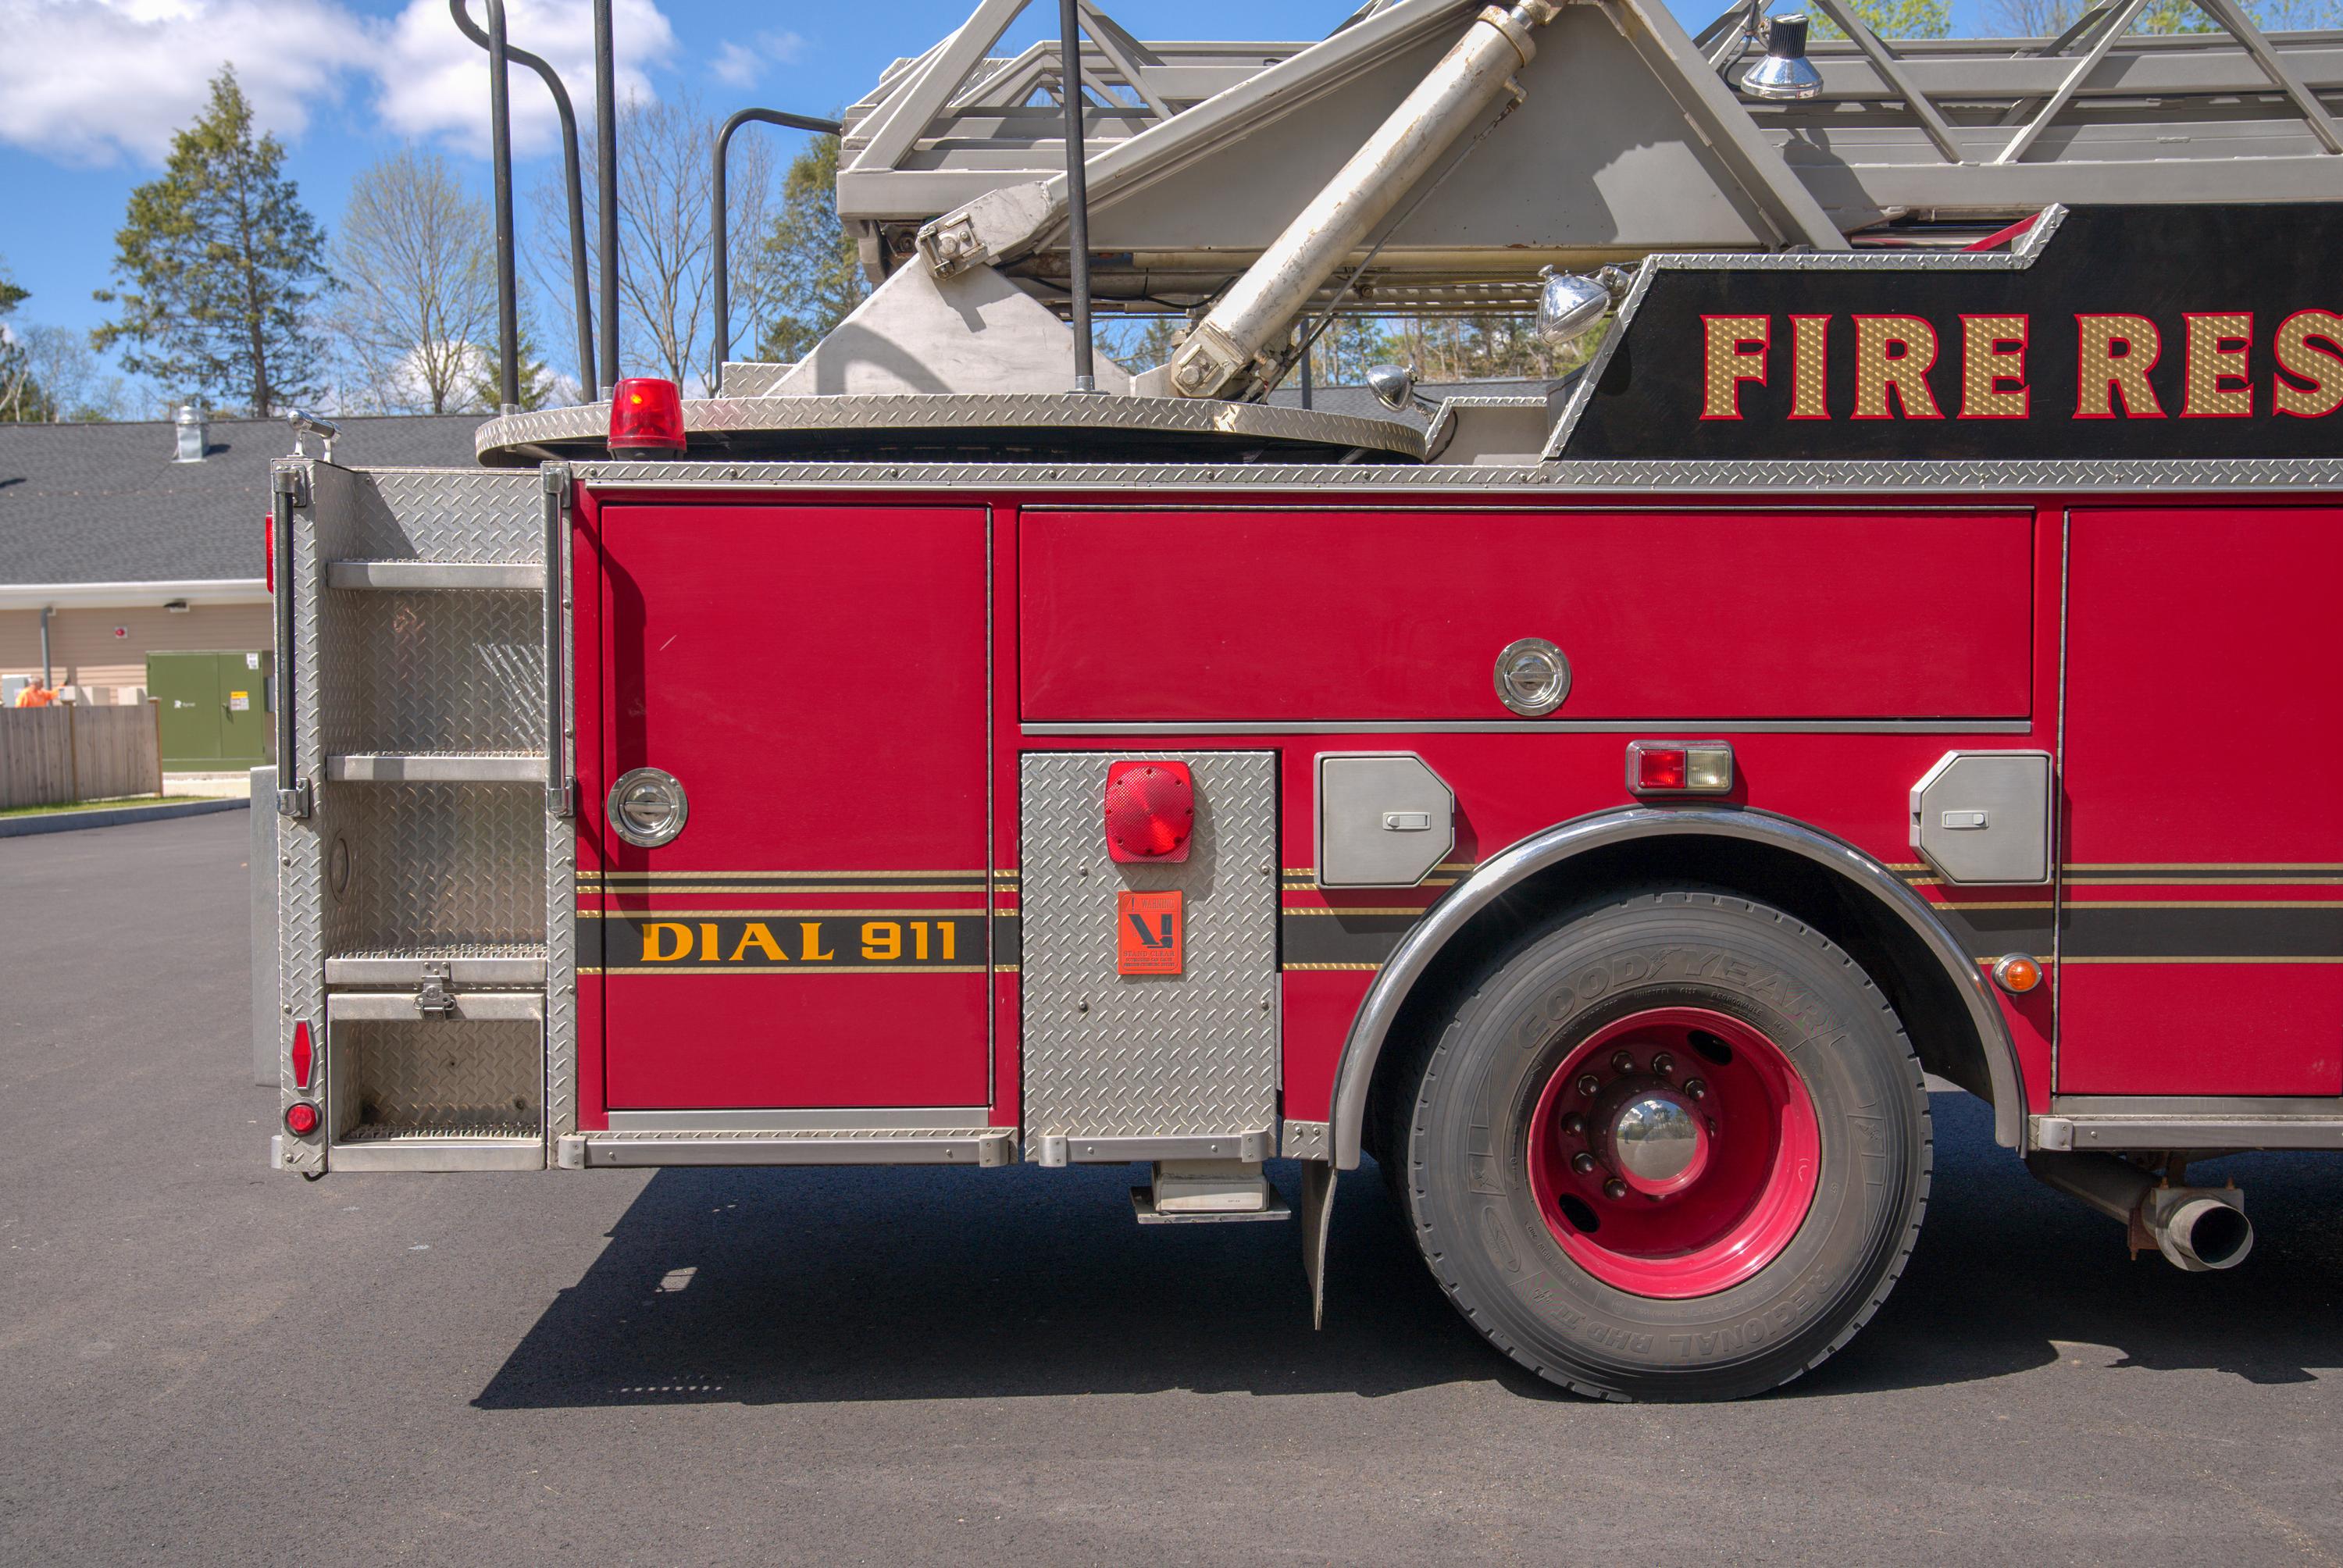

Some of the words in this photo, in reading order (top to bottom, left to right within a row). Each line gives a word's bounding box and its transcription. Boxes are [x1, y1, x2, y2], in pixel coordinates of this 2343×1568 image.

[1699, 314, 2031, 420] FIRE
[2071, 308, 2343, 419] RES
[1142, 898, 1175, 909] WARNING
[640, 922, 834, 960] DIAL
[861, 921, 955, 960] 911
[1517, 949, 1831, 1050] GOODYEAR
[1587, 1321, 1655, 1355] RHD
[1668, 1264, 1836, 1357] REGIONAL
